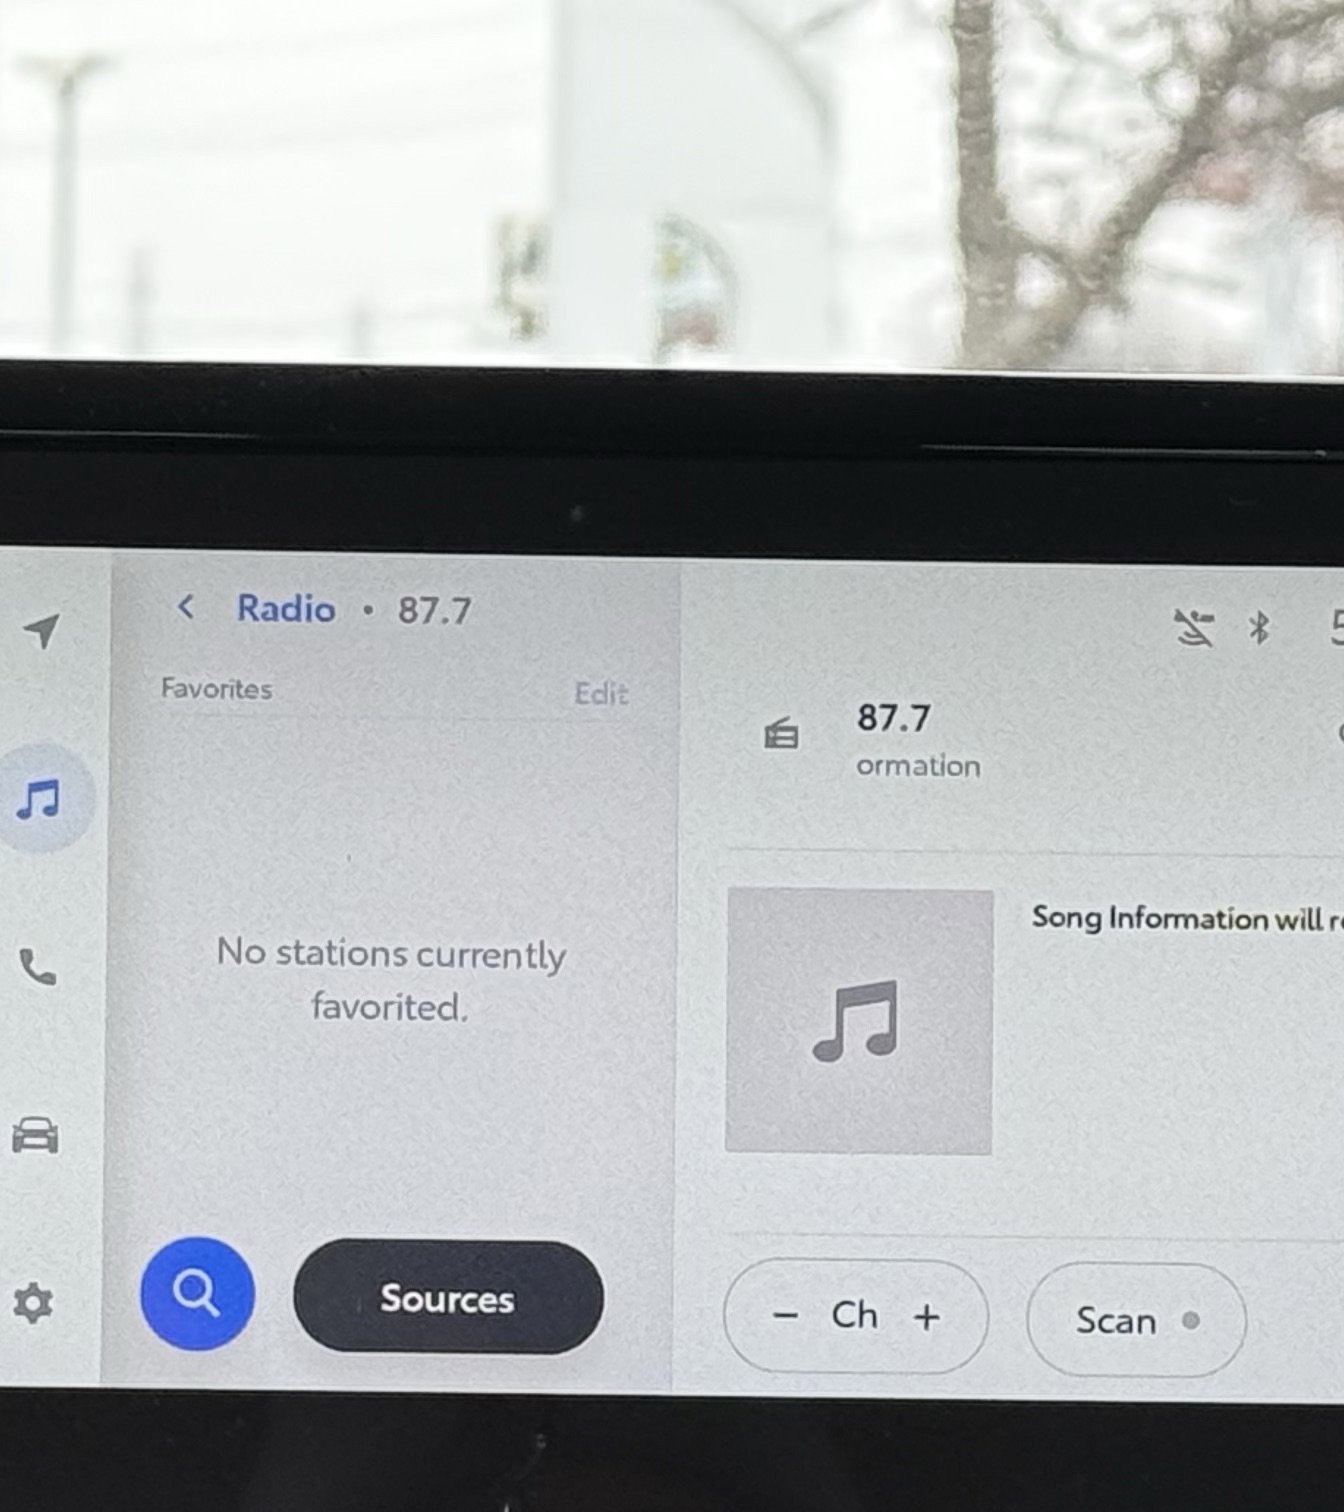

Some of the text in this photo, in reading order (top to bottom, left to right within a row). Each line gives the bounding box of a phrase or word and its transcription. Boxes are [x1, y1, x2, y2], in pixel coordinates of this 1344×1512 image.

[239, 593, 471, 625] Radio 87.7
[162, 677, 272, 701] Favorites
[575, 681, 629, 706] Edit
[858, 704, 931, 732] 87.7
[857, 753, 981, 778] ormation
[1033, 904, 1103, 935] Song
[1109, 905, 1269, 931] Information
[1275, 907, 1324, 931] will
[219, 936, 567, 977] No stations currently
[312, 990, 467, 1022] favorited.
[381, 1282, 515, 1314] Sources
[833, 1299, 878, 1329] Ch
[1077, 1305, 1157, 1334] Scan
